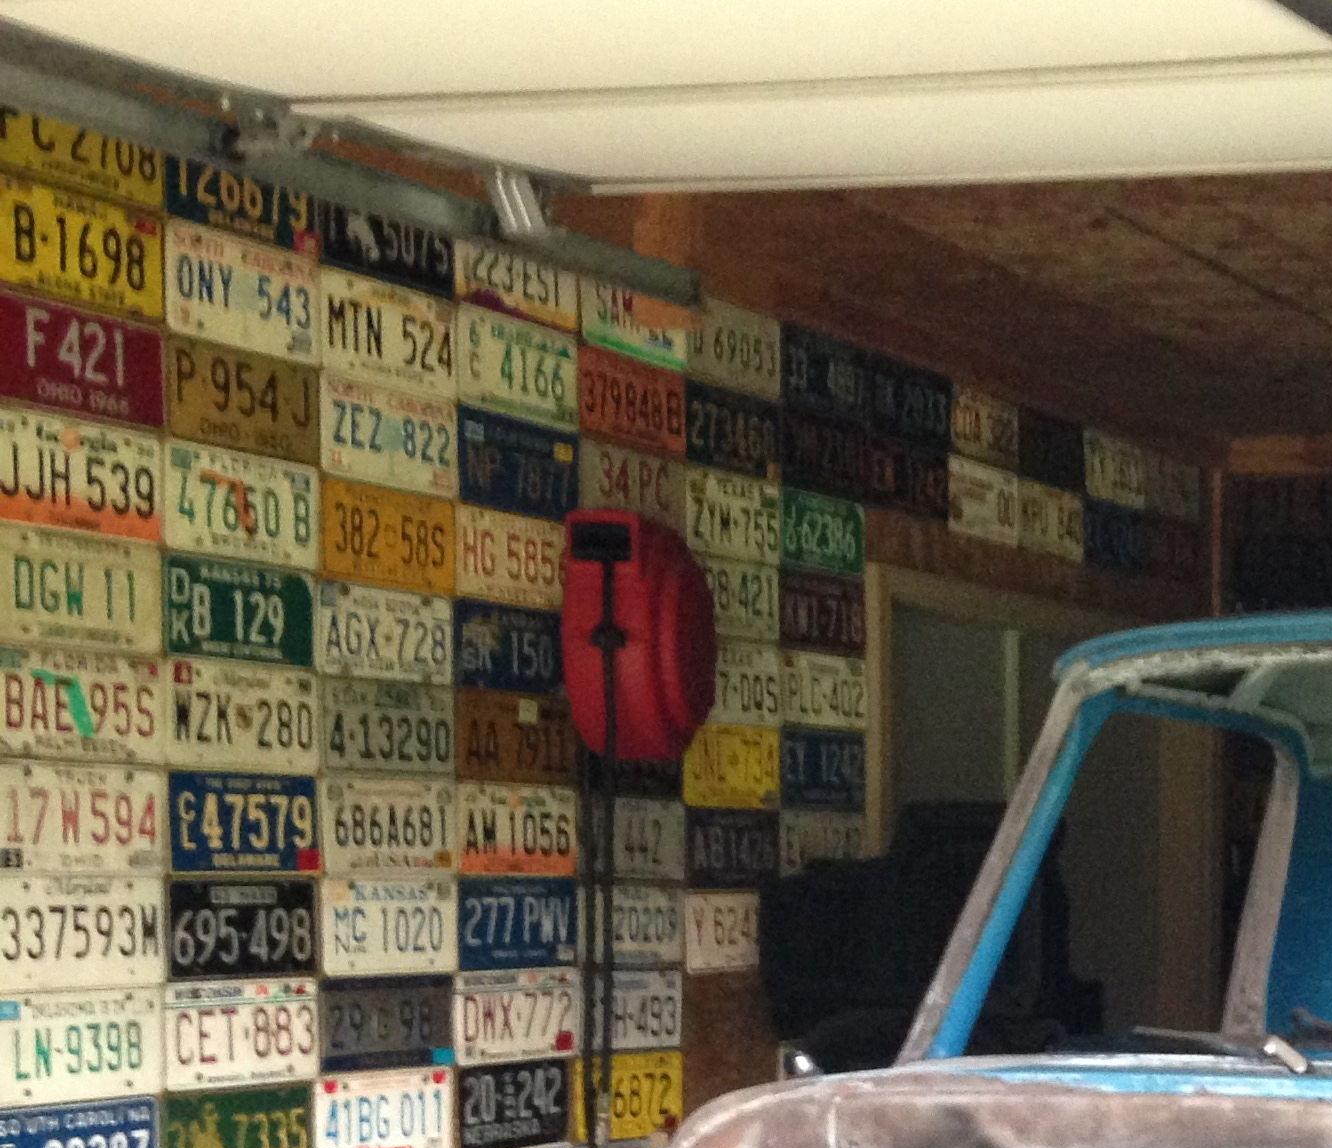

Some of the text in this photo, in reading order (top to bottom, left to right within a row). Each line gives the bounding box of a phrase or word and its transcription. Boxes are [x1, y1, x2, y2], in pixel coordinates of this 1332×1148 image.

[256, 274, 312, 331] 543
[25, 307, 125, 388] F 421
[327, 295, 452, 378] MTN 524
[175, 351, 196, 404] P
[210, 358, 279, 423] 954
[290, 376, 312, 429] J
[500, 343, 566, 402] 4166
[332, 399, 383, 455] ZEZ
[401, 415, 451, 467] 822
[0, 441, 155, 520] JJH 539
[294, 492, 312, 545] B
[335, 501, 380, 559] 382
[461, 526, 556, 584] HG 585
[14, 556, 84, 617] DGW
[232, 588, 285, 645] 129
[202, 792, 314, 851] 47579
[508, 810, 571, 856] 1056
[353, 884, 429, 903] KANSAS
[464, 894, 515, 947] 277
[380, 906, 443, 953] 1020
[515, 1065, 563, 1119] 242
[613, 1072, 672, 1124] 6872
